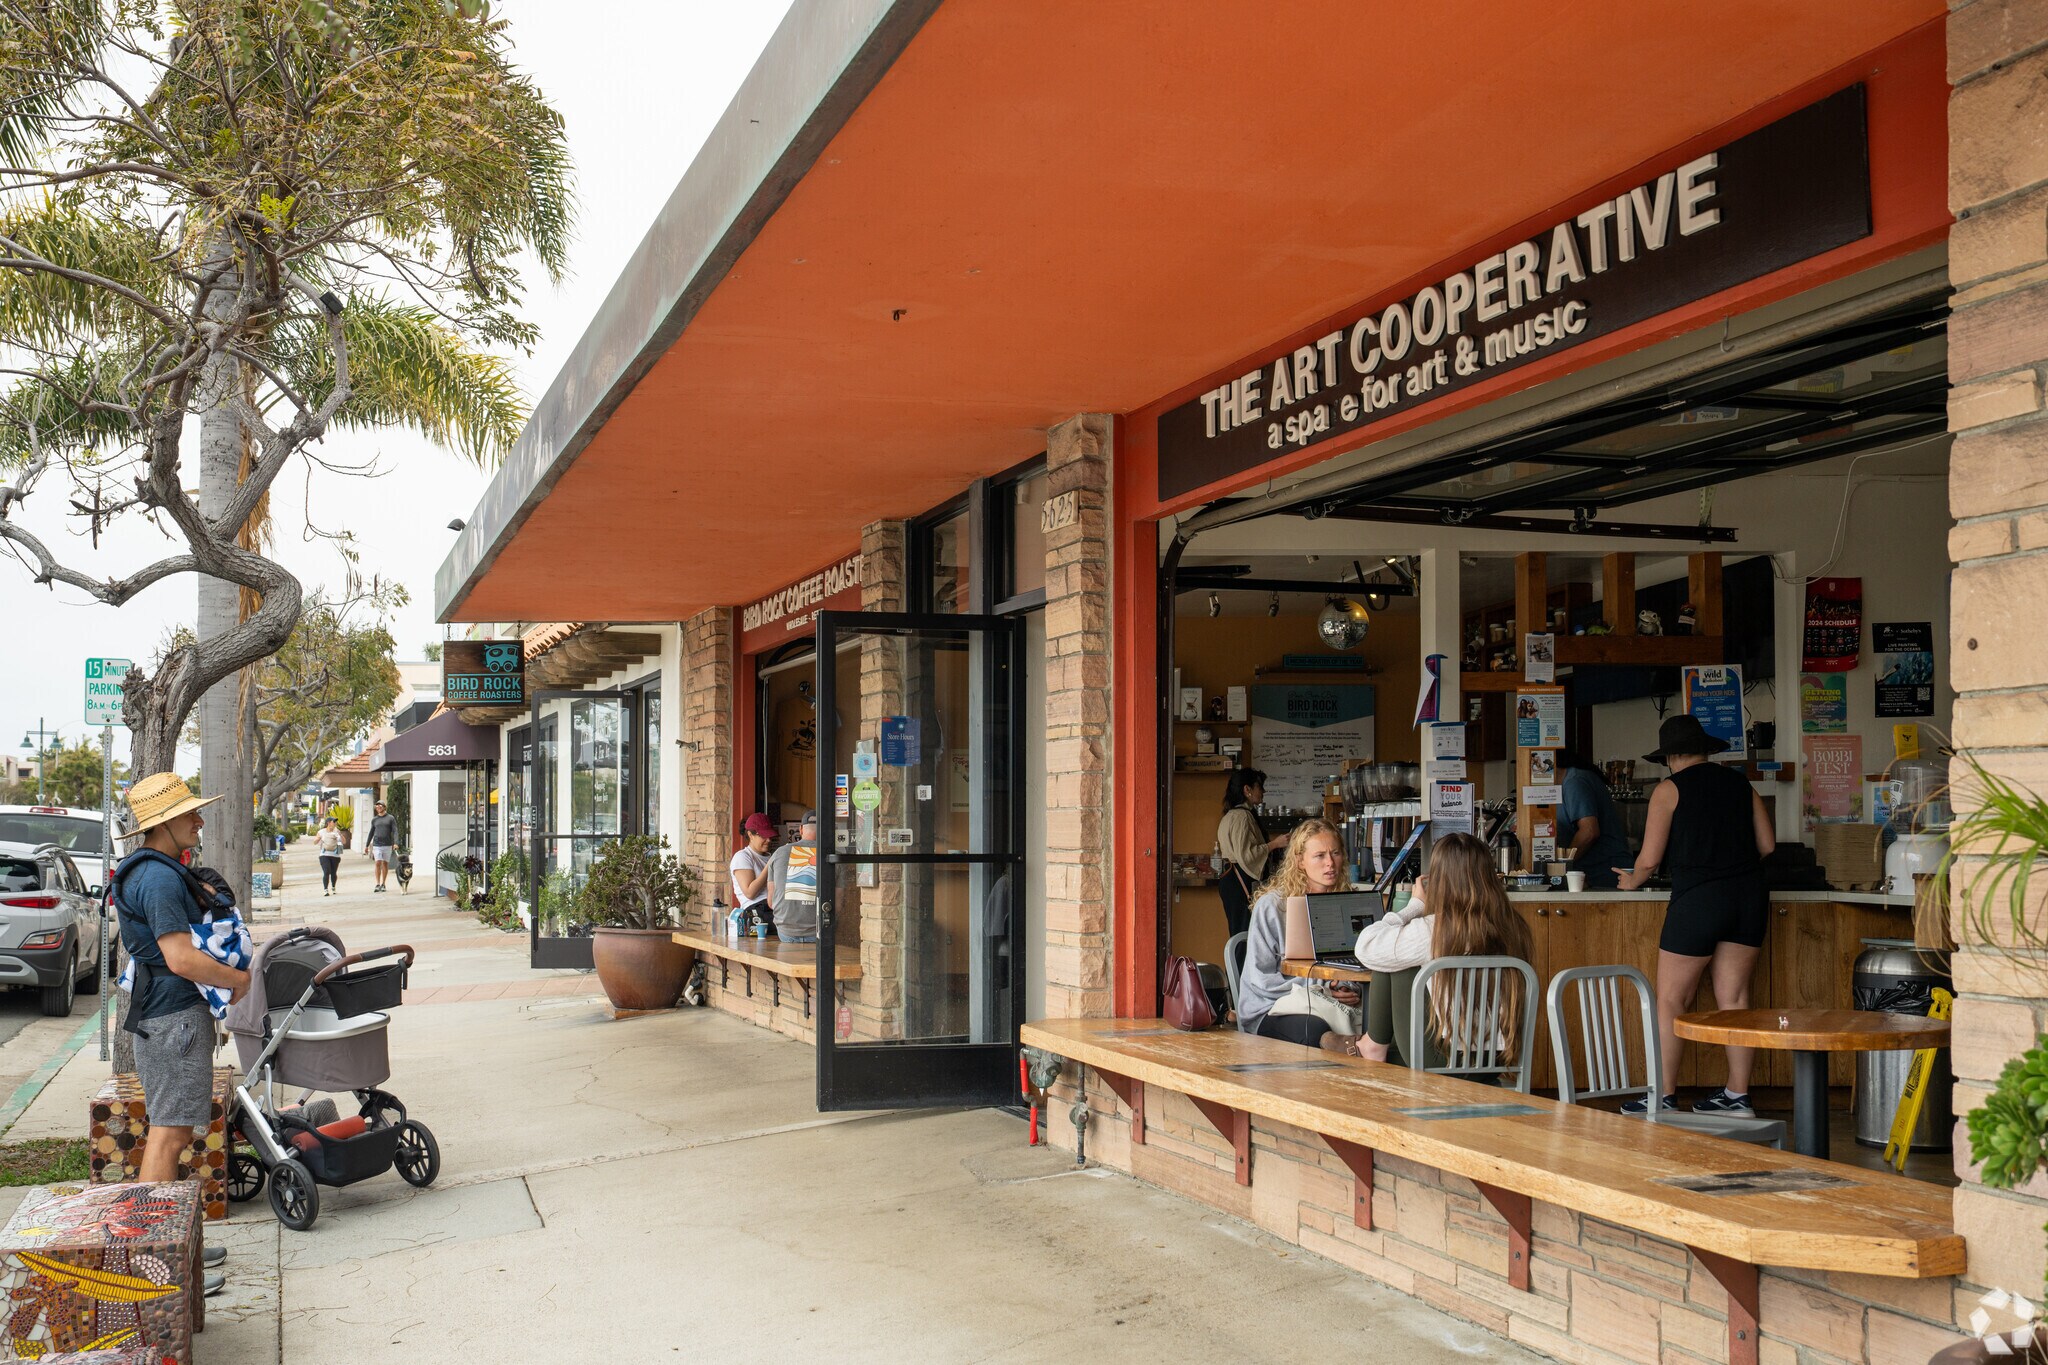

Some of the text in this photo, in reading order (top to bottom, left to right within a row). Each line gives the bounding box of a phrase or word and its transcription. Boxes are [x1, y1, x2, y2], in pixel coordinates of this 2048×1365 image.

[1200, 152, 1720, 438] THE ART COOPERATIVE
[1267, 422, 1283, 449] a
[1361, 373, 1402, 413] for
[1406, 349, 1449, 396] art
[1455, 335, 1480, 376] &
[1485, 300, 1587, 366] music
[743, 603, 762, 632] BIRD
[762, 590, 787, 625] ROCK
[786, 573, 824, 614] COFFEE
[88, 661, 101, 677] 15
[1704, 669, 1722, 678] wild
[89, 683, 125, 696] PARKIN
[447, 677, 522, 691] BIRD ROCK
[448, 690, 522, 699] COFFEE ROASTERS
[1288, 700, 1338, 711] BIRD ROCK
[887, 733, 915, 741] Store Hours
[428, 745, 457, 756] 5631
[1812, 750, 1853, 762] BOBBI
[1815, 762, 1851, 774] FEST
[1441, 800, 1463, 808] balance
